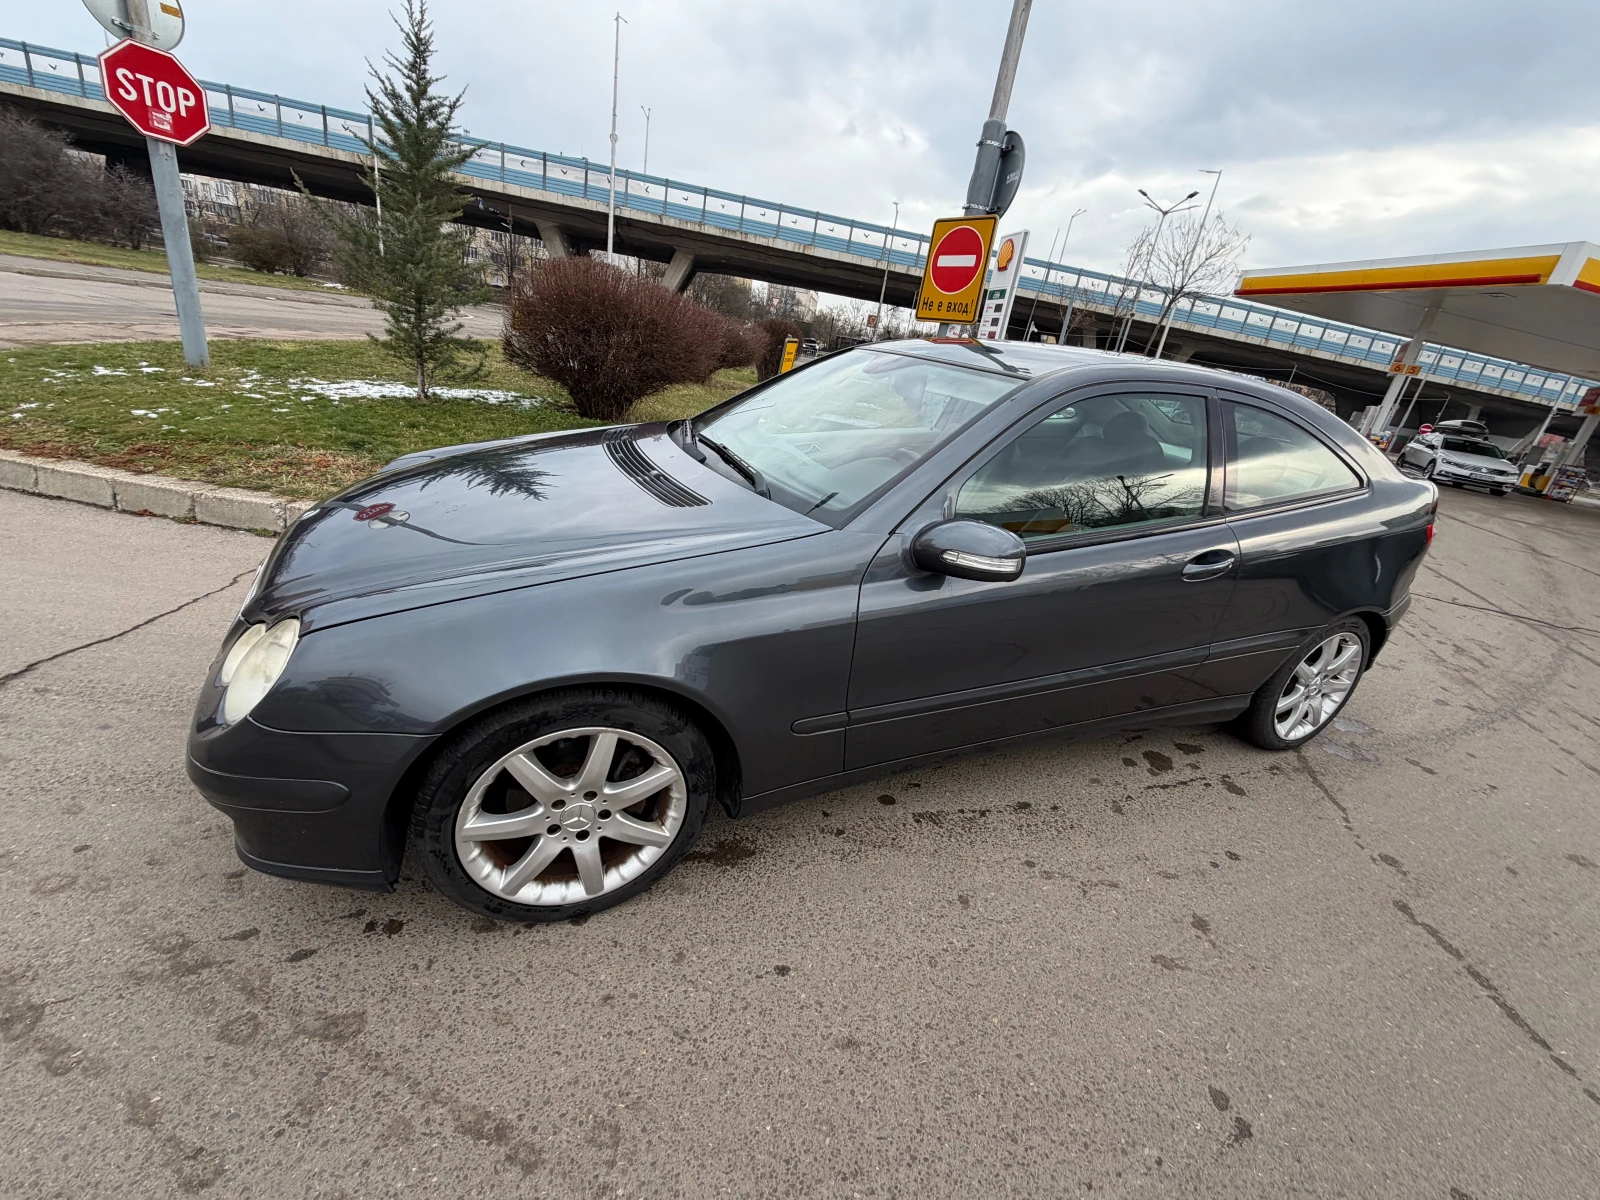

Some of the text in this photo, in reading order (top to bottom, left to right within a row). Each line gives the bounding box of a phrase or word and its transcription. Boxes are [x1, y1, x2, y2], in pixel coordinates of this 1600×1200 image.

[115, 67, 195, 117] STOP
[921, 296, 934, 312] Не
[937, 300, 943, 312] е
[946, 299, 974, 316] вход!
